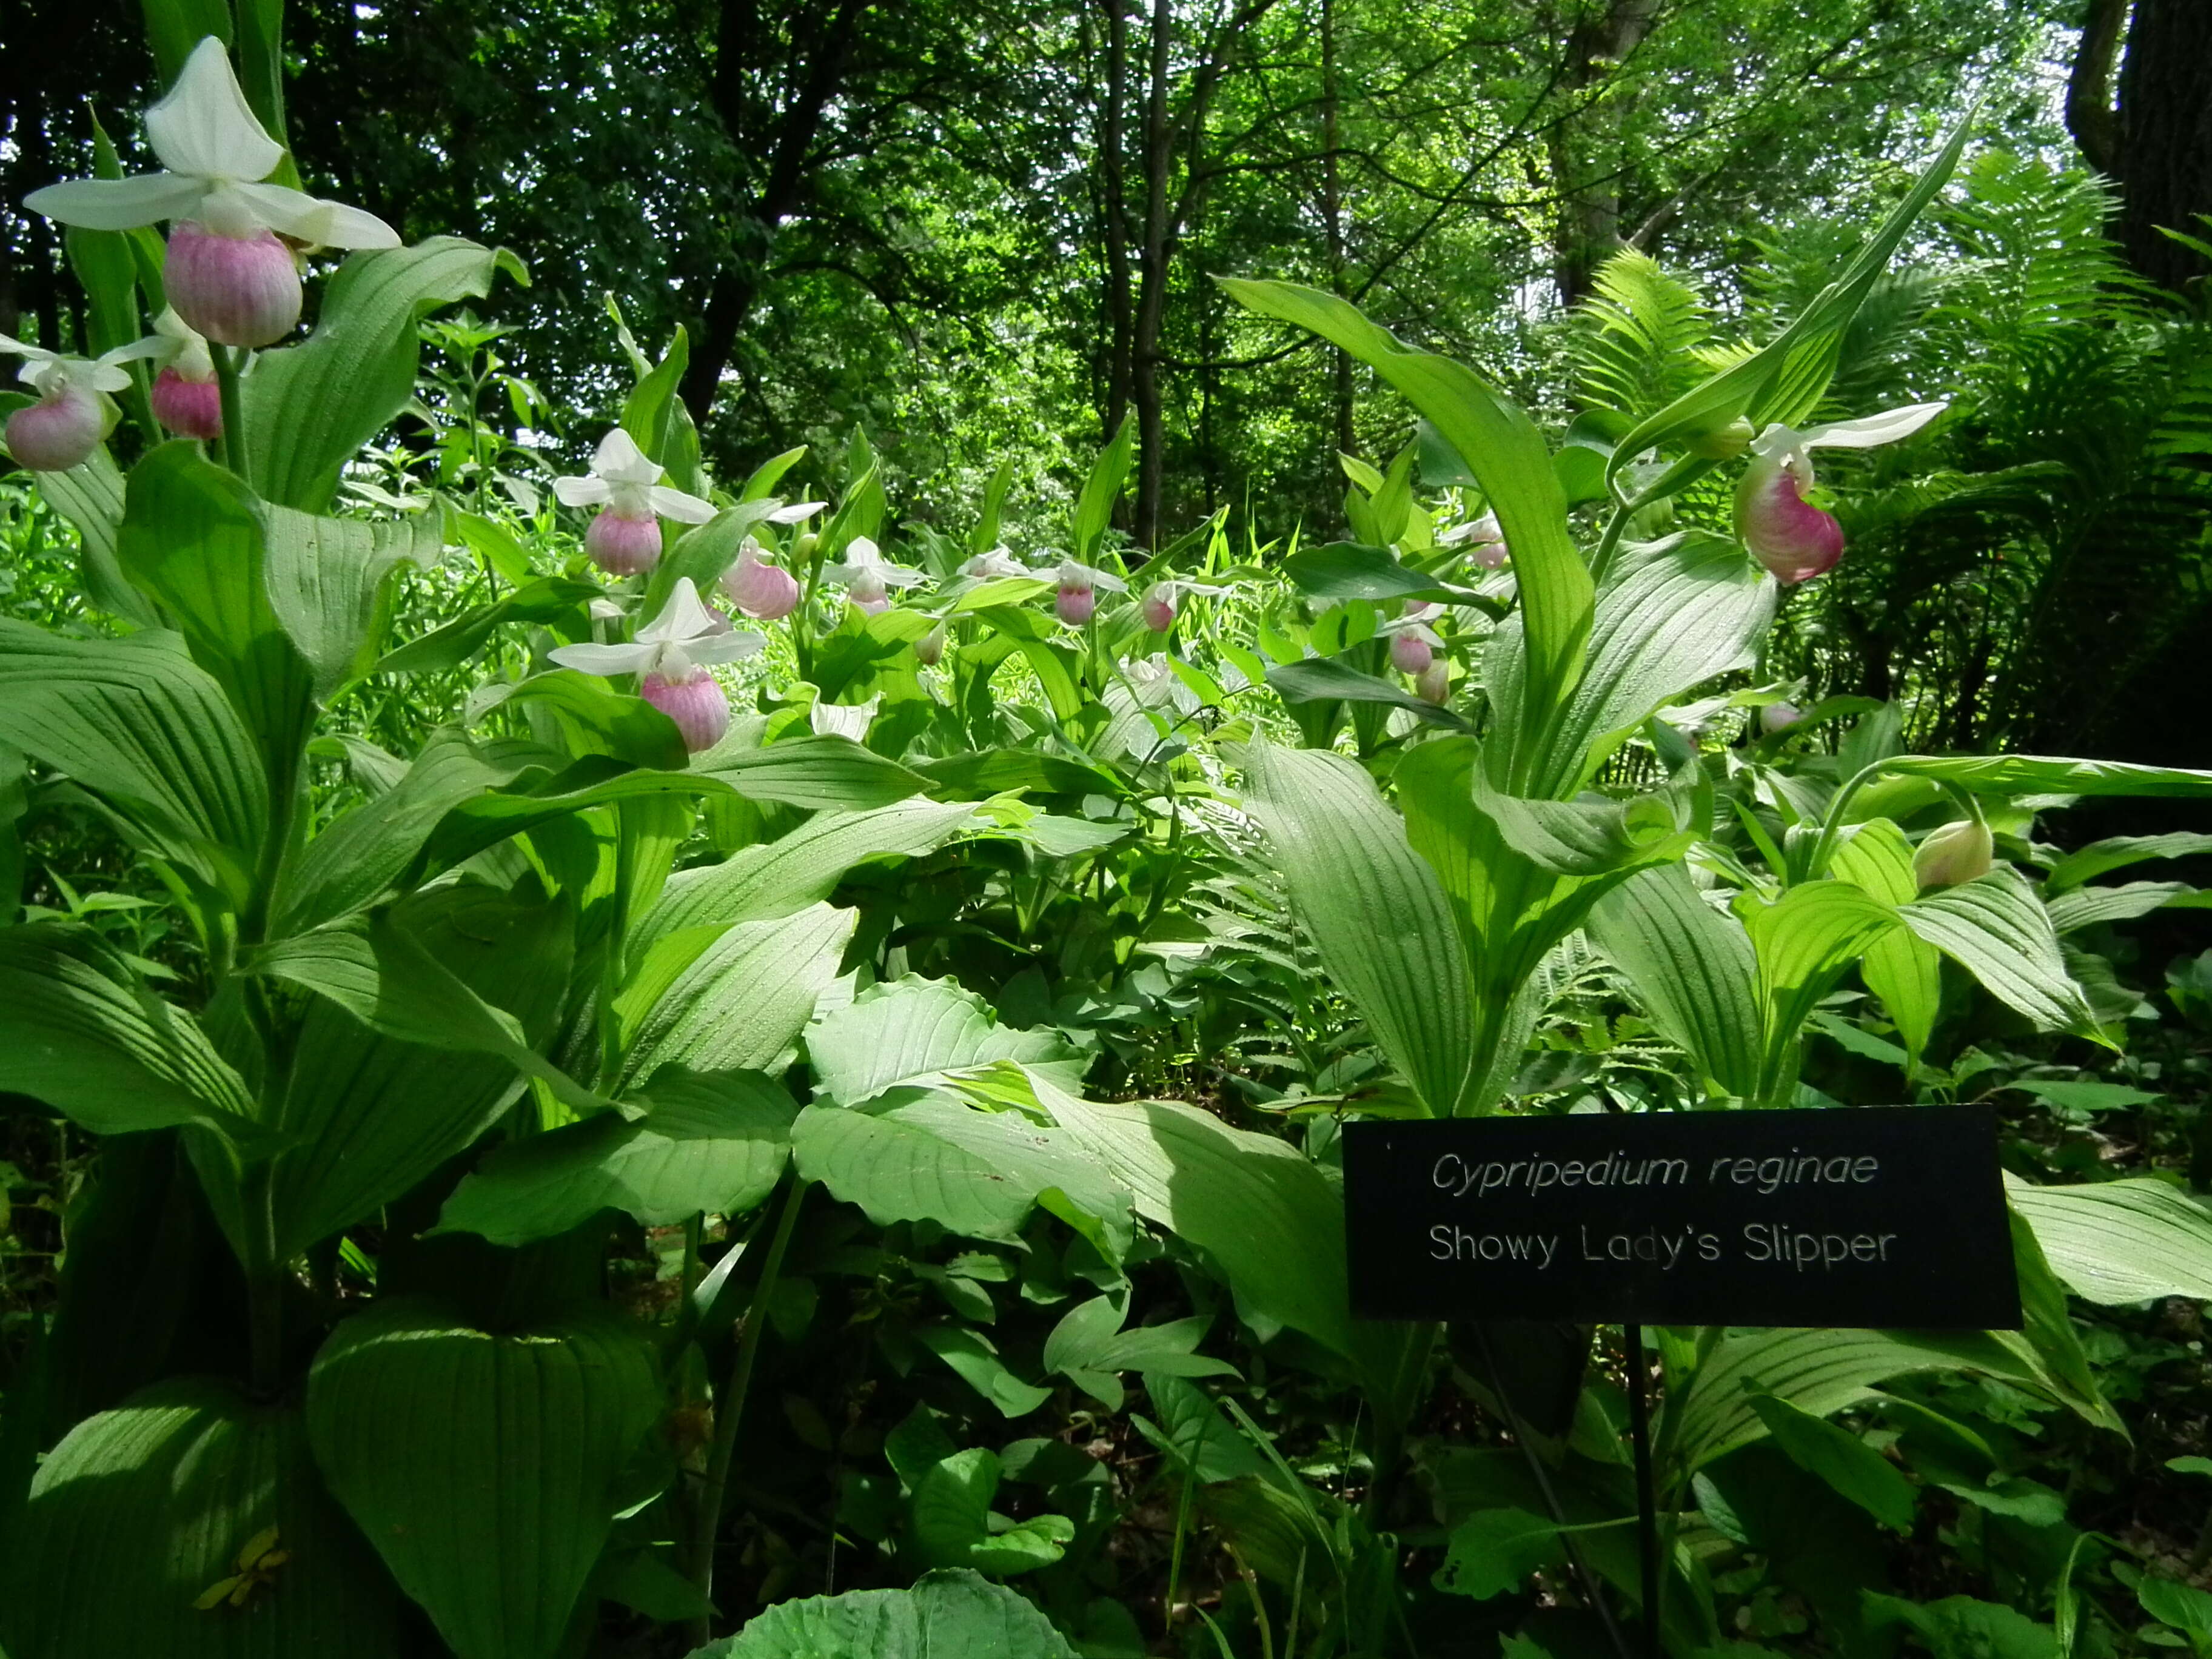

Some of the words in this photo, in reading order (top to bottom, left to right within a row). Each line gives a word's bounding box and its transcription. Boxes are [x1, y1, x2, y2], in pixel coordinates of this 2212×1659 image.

[1433, 1150, 1688, 1197] Cypripedium
[1709, 1147, 1879, 1194] reginae
[1430, 1224, 1558, 1270] Showy
[1581, 1224, 1720, 1270] Lady's
[1744, 1223, 1897, 1272] Slipper
